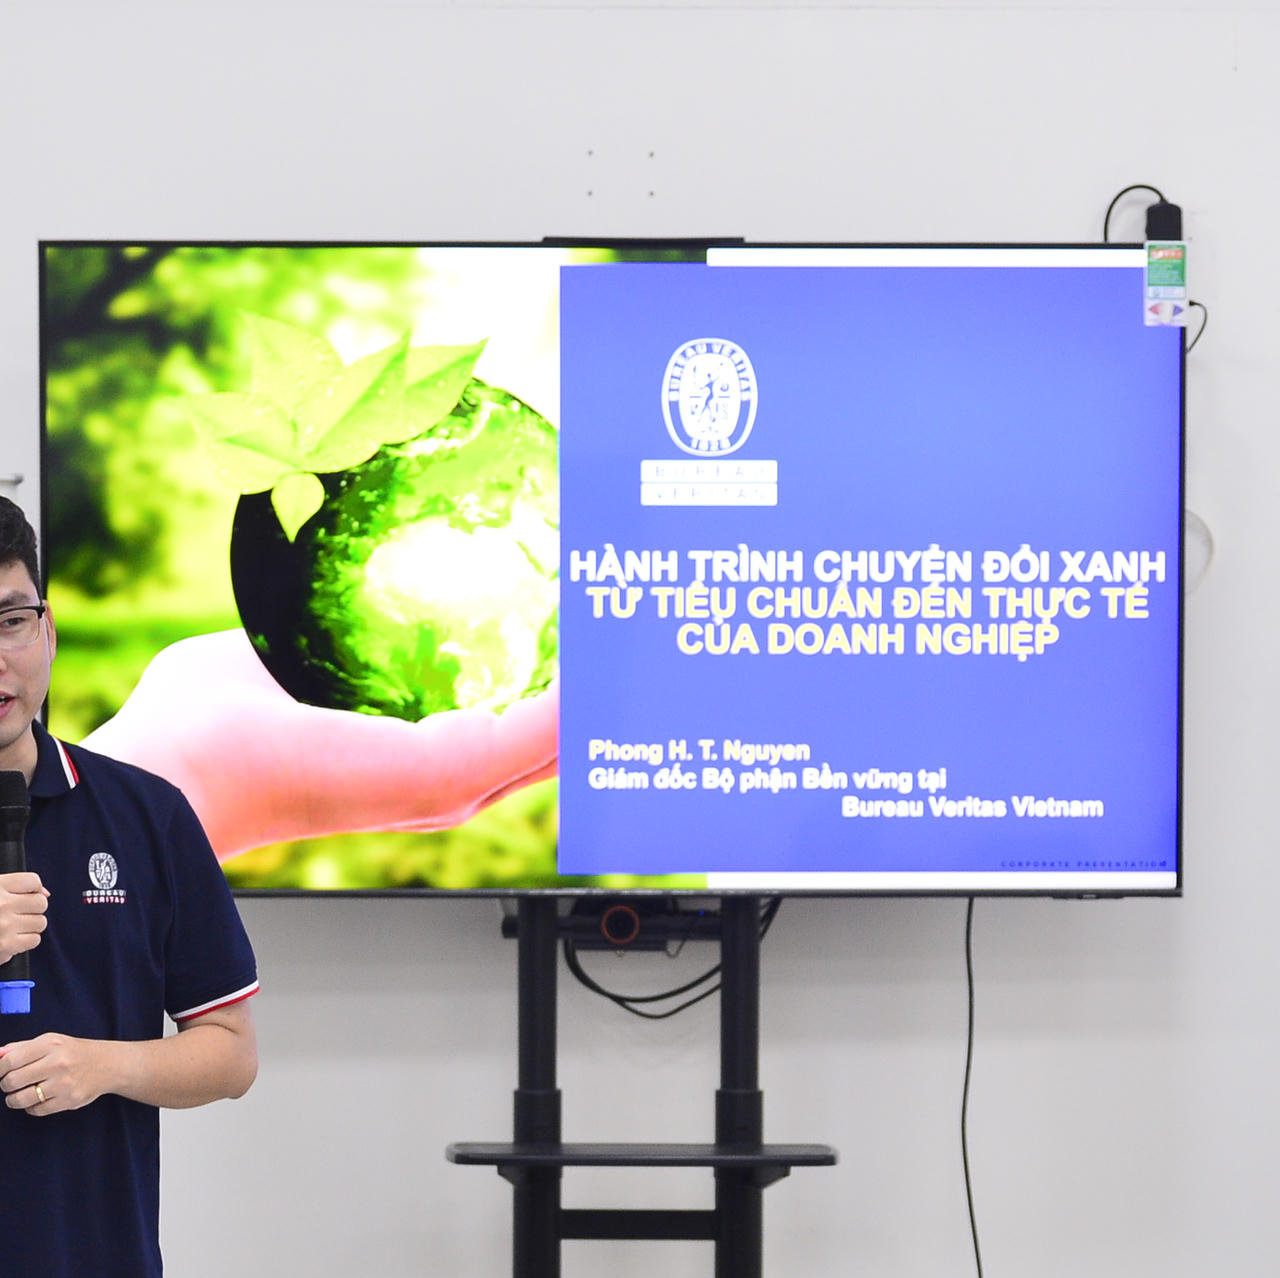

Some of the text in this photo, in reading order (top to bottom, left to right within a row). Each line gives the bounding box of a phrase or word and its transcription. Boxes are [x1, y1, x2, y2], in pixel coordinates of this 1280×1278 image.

[570, 543, 678, 583] HÀNH
[688, 543, 803, 583] TRÌNH
[1058, 550, 1166, 583] XANH
[585, 580, 643, 618] TỪ
[650, 579, 736, 618] TIÊU
[892, 580, 972, 618] ĐẾN
[981, 586, 1091, 626] THỰC
[1100, 580, 1149, 619] TẾ
[677, 615, 1060, 662] CỦA DOANH NGHIỆP
[588, 739, 811, 766] Phong H. T. Nguyen
[587, 762, 948, 794] Giám đốc Bộ phận Bền vững tại
[841, 796, 1105, 818] Bureau Veritas Vietnam
